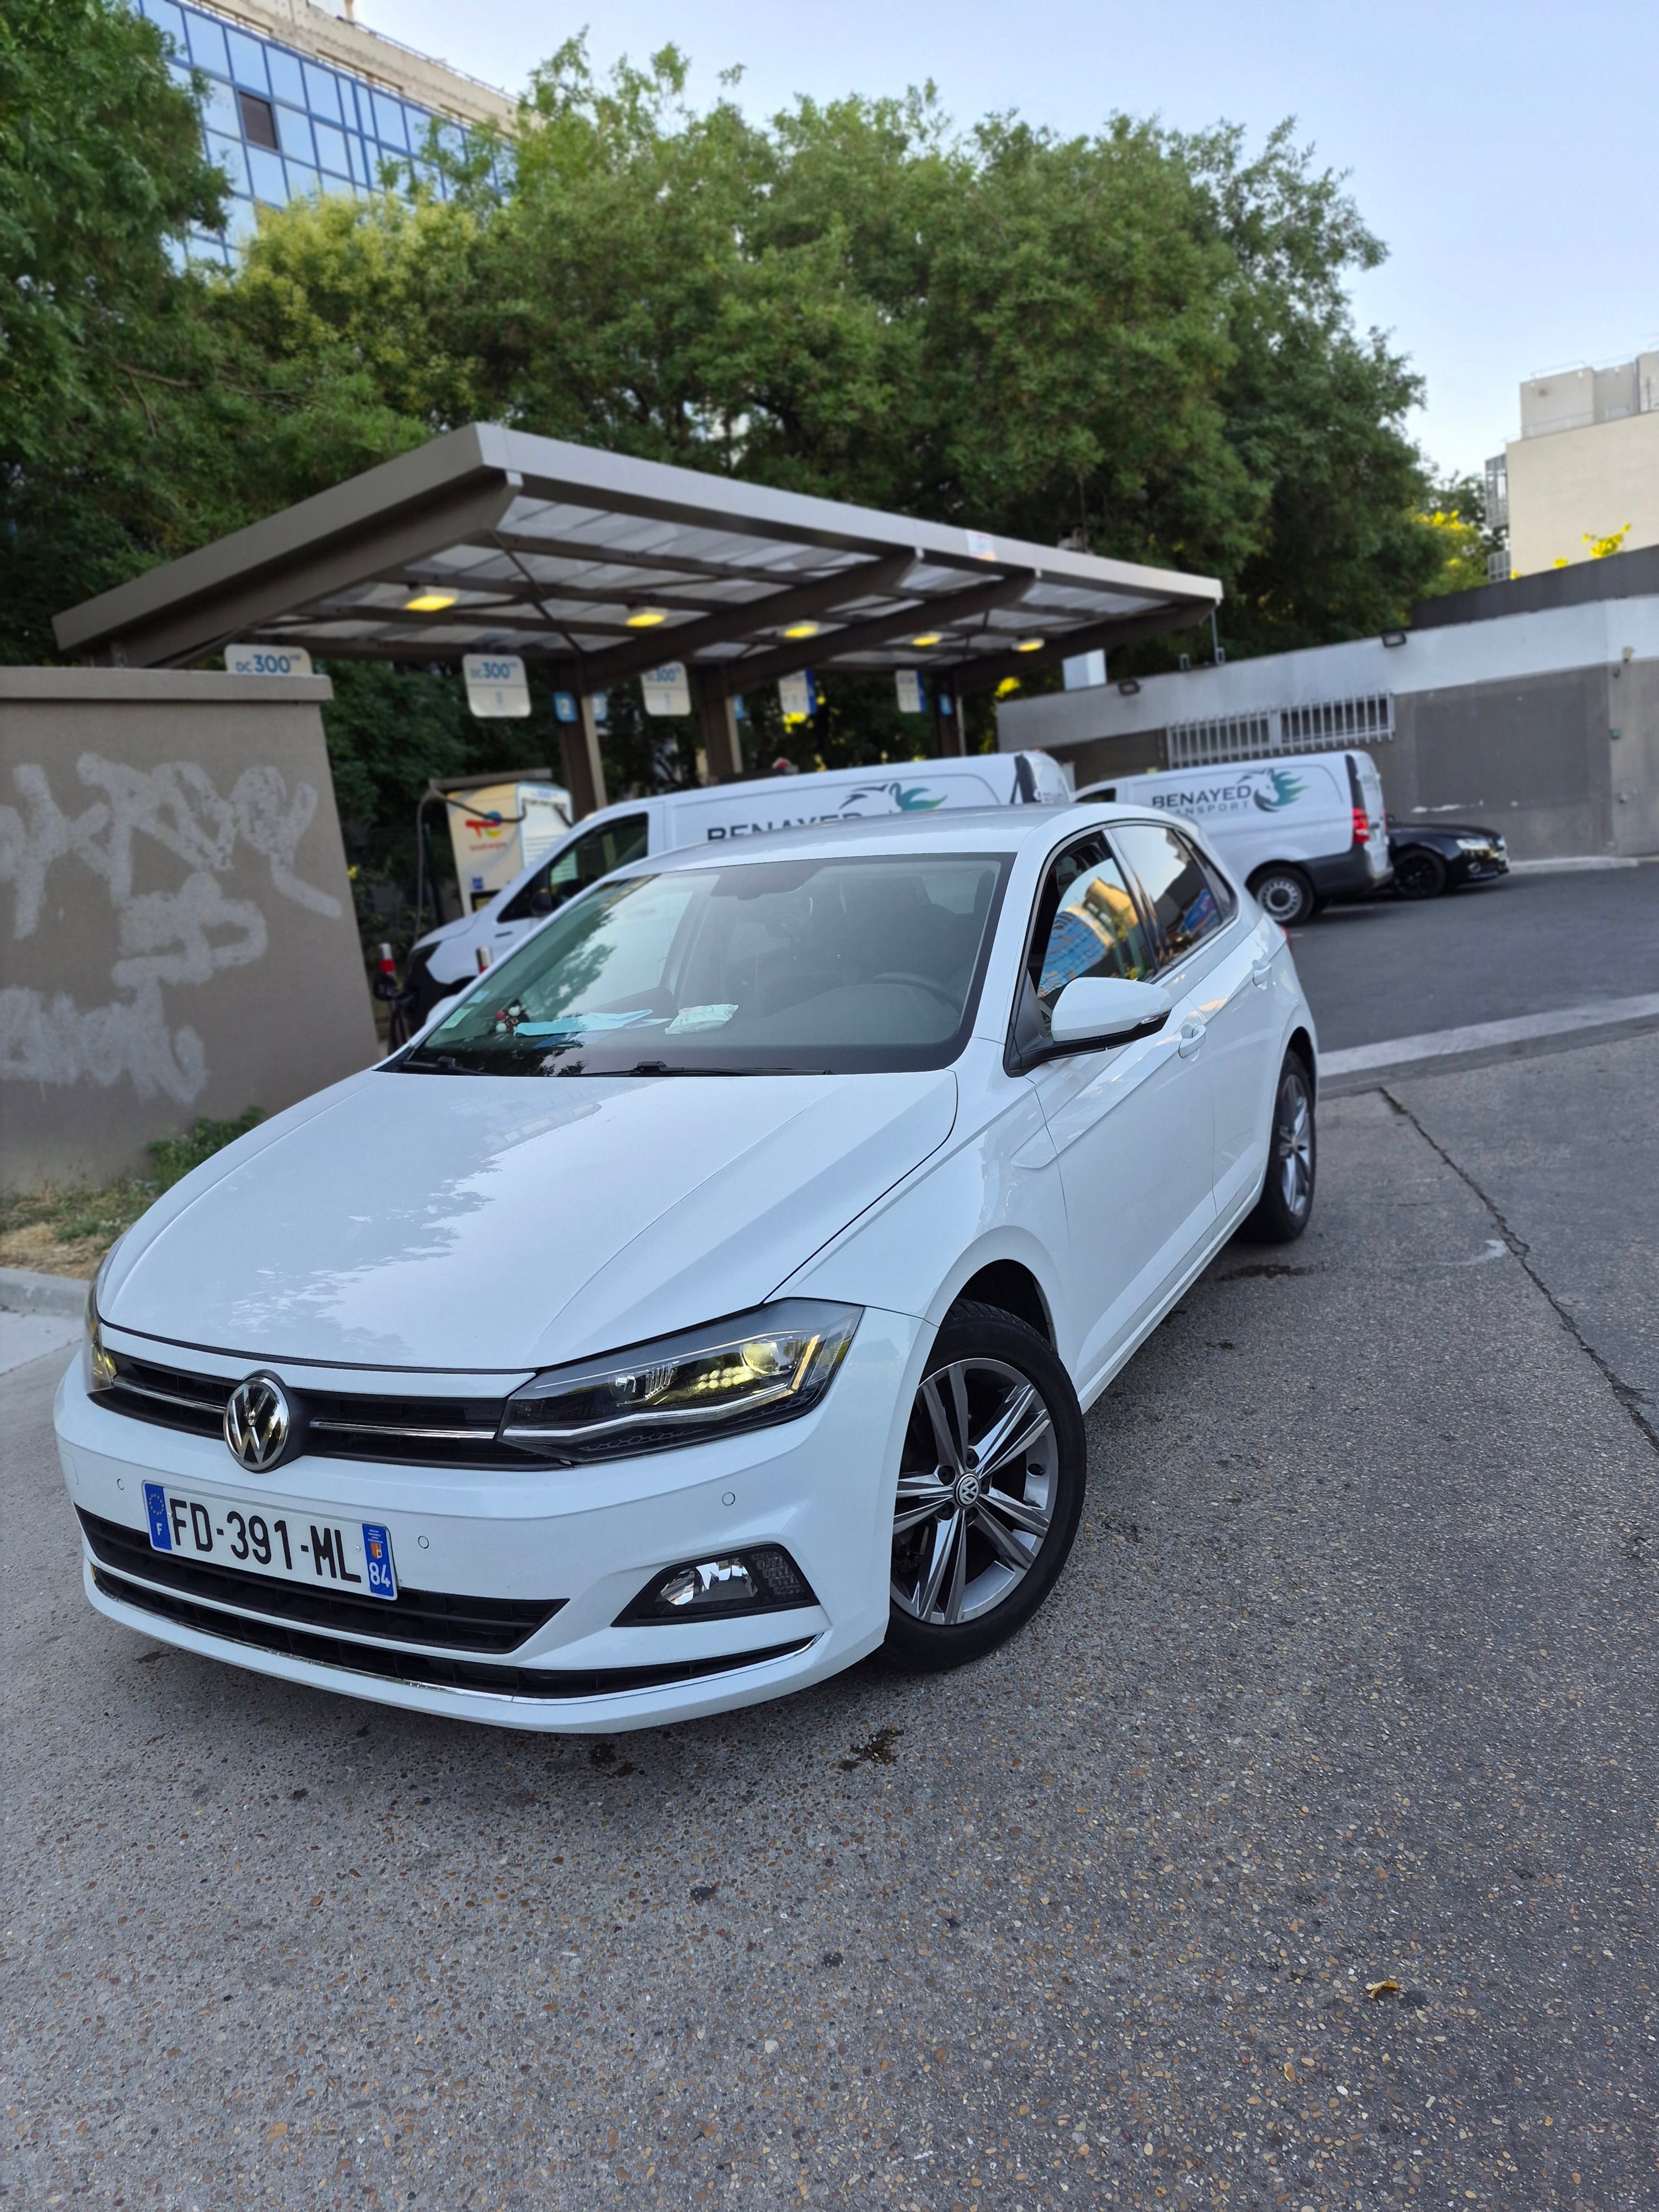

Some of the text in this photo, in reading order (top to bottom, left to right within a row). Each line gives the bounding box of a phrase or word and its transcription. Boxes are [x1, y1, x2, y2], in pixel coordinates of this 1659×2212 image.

[253, 654, 290, 673] 300
[482, 661, 510, 680] 300
[561, 698, 571, 715] 2
[1152, 785, 1251, 808] BENAYED
[1176, 800, 1249, 815] ANSPORT
[156, 1522, 163, 1536] F
[169, 1498, 362, 1583] FD-391-ML
[369, 1562, 391, 1588] 84
